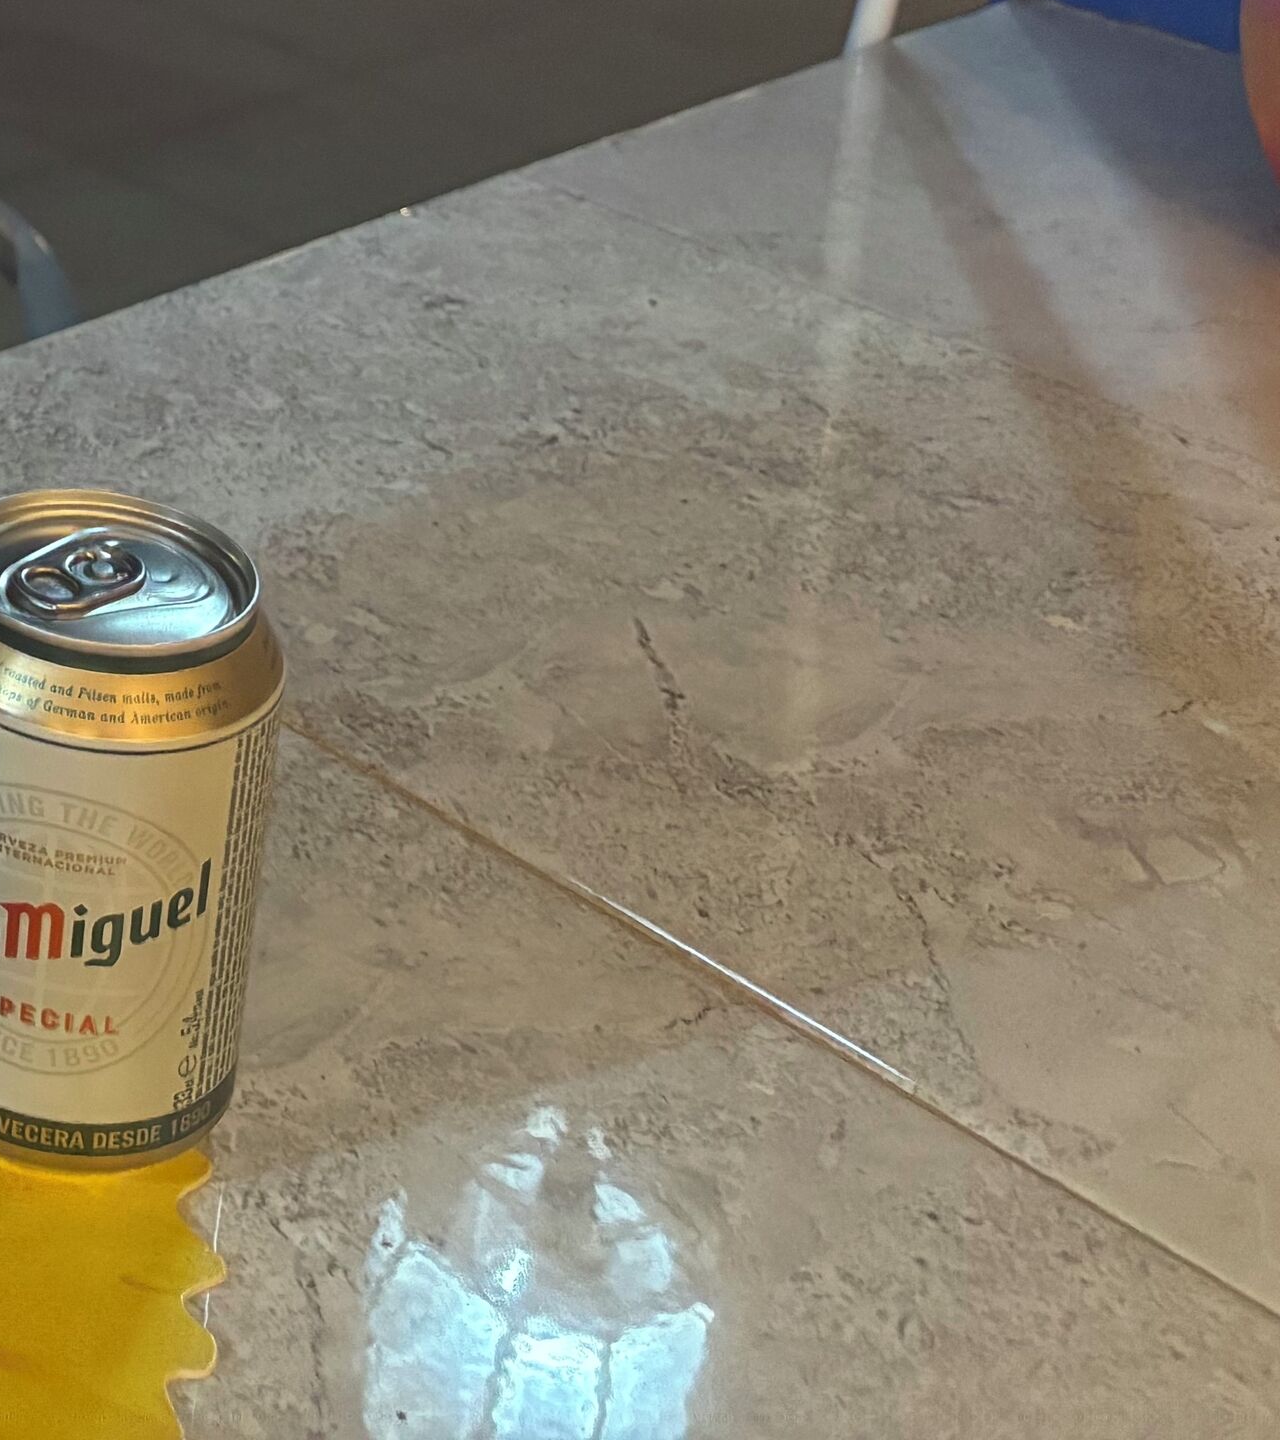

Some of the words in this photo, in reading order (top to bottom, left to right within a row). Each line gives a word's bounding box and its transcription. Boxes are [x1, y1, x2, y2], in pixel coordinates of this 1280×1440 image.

[4, 667, 47, 690] roasted
[50, 683, 73, 697] and
[78, 686, 117, 704] Pilsen
[122, 691, 160, 706] malts,
[164, 686, 194, 703] made
[197, 680, 222, 699] from
[27, 697, 41, 710] of
[43, 699, 96, 721] German
[100, 712, 125, 724] and
[131, 709, 192, 725] American
[59, 801, 119, 838] THE
[54, 849, 128, 866] PREMIUM
[47, 1037, 119, 1068] 1890
[93, 1124, 162, 1150] DESDE
[171, 1100, 211, 1140] 1890
